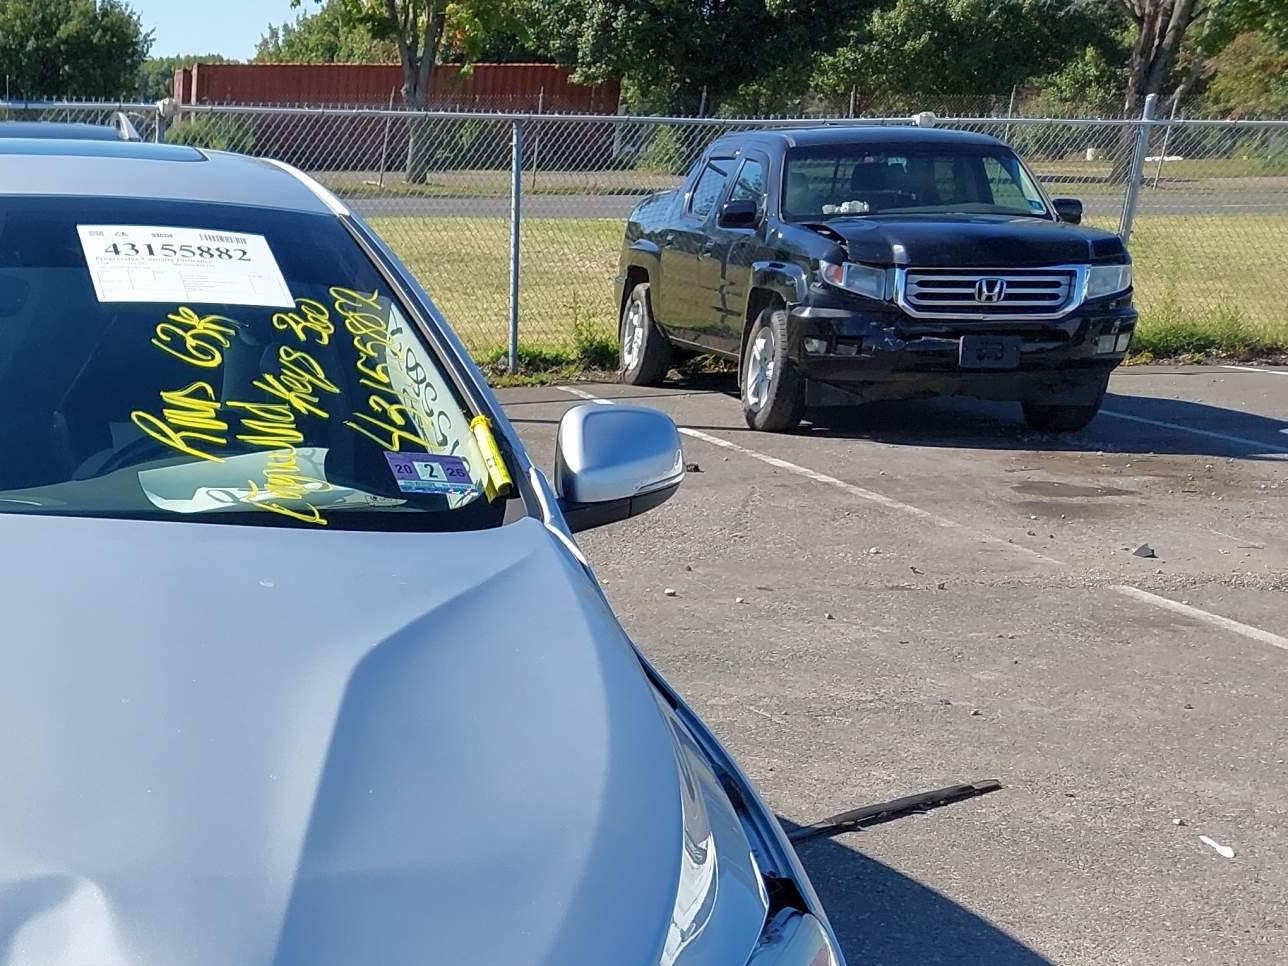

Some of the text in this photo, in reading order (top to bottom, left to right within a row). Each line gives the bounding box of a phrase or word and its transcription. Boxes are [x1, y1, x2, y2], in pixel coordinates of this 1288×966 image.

[104, 242, 252, 262] 43155882
[395, 463, 466, 479] 20 2 26
